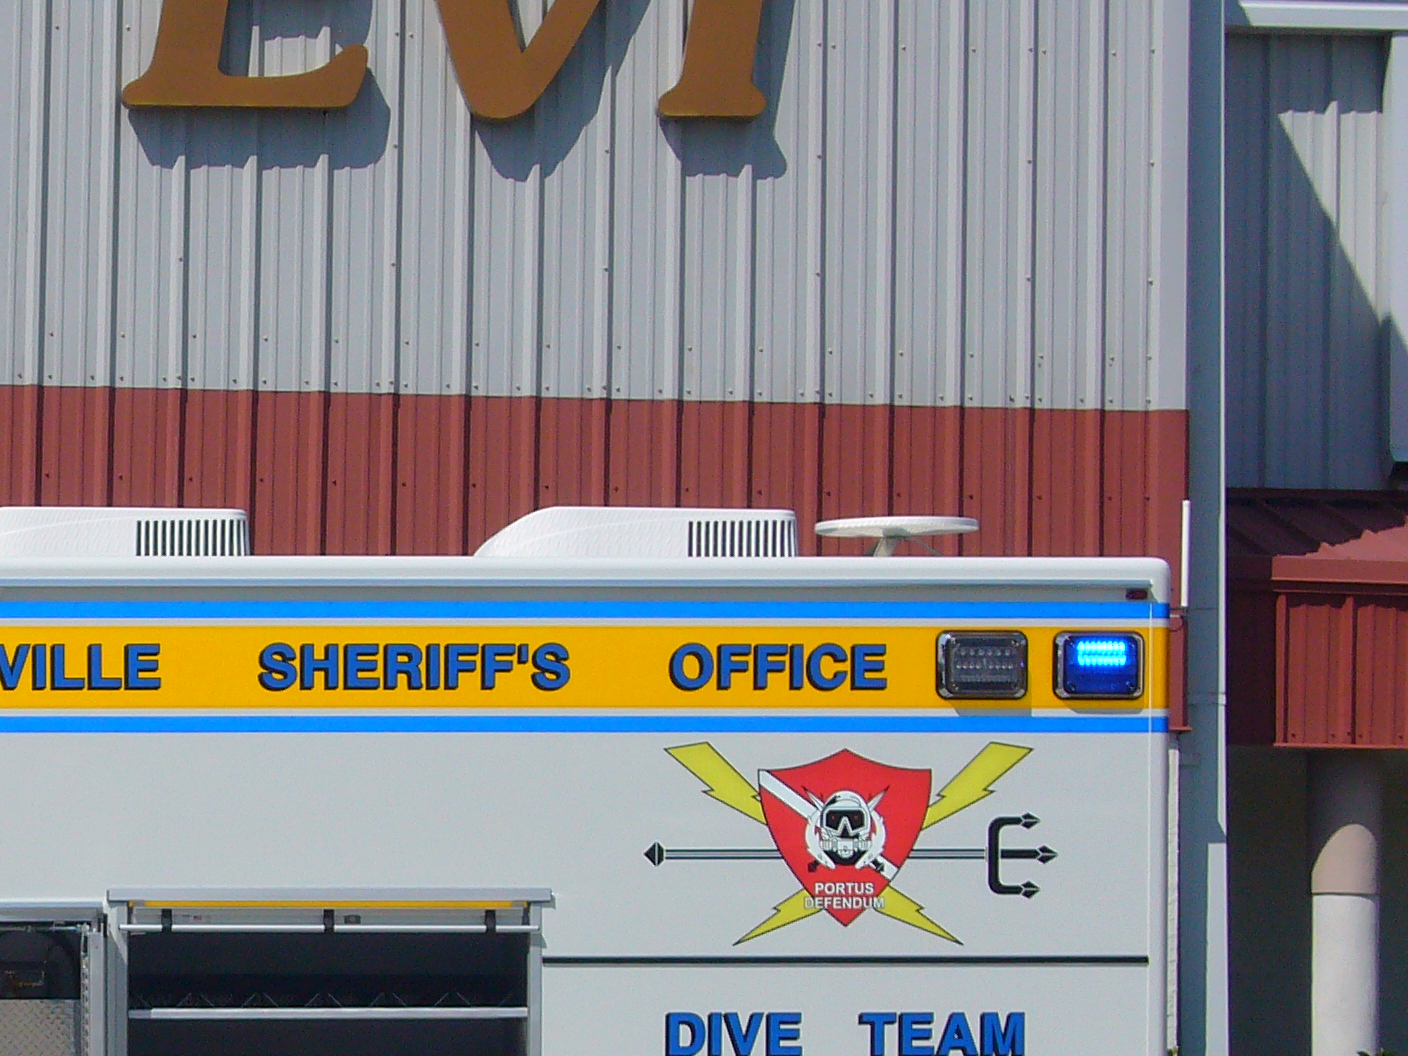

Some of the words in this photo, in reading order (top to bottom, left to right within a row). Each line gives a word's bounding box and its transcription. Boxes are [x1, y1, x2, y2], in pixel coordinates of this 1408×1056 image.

[257, 643, 571, 691] SHERIFF'S
[668, 643, 888, 691] OFFICE
[815, 883, 874, 894] PORTUS
[805, 897, 884, 908] DEFENDUM
